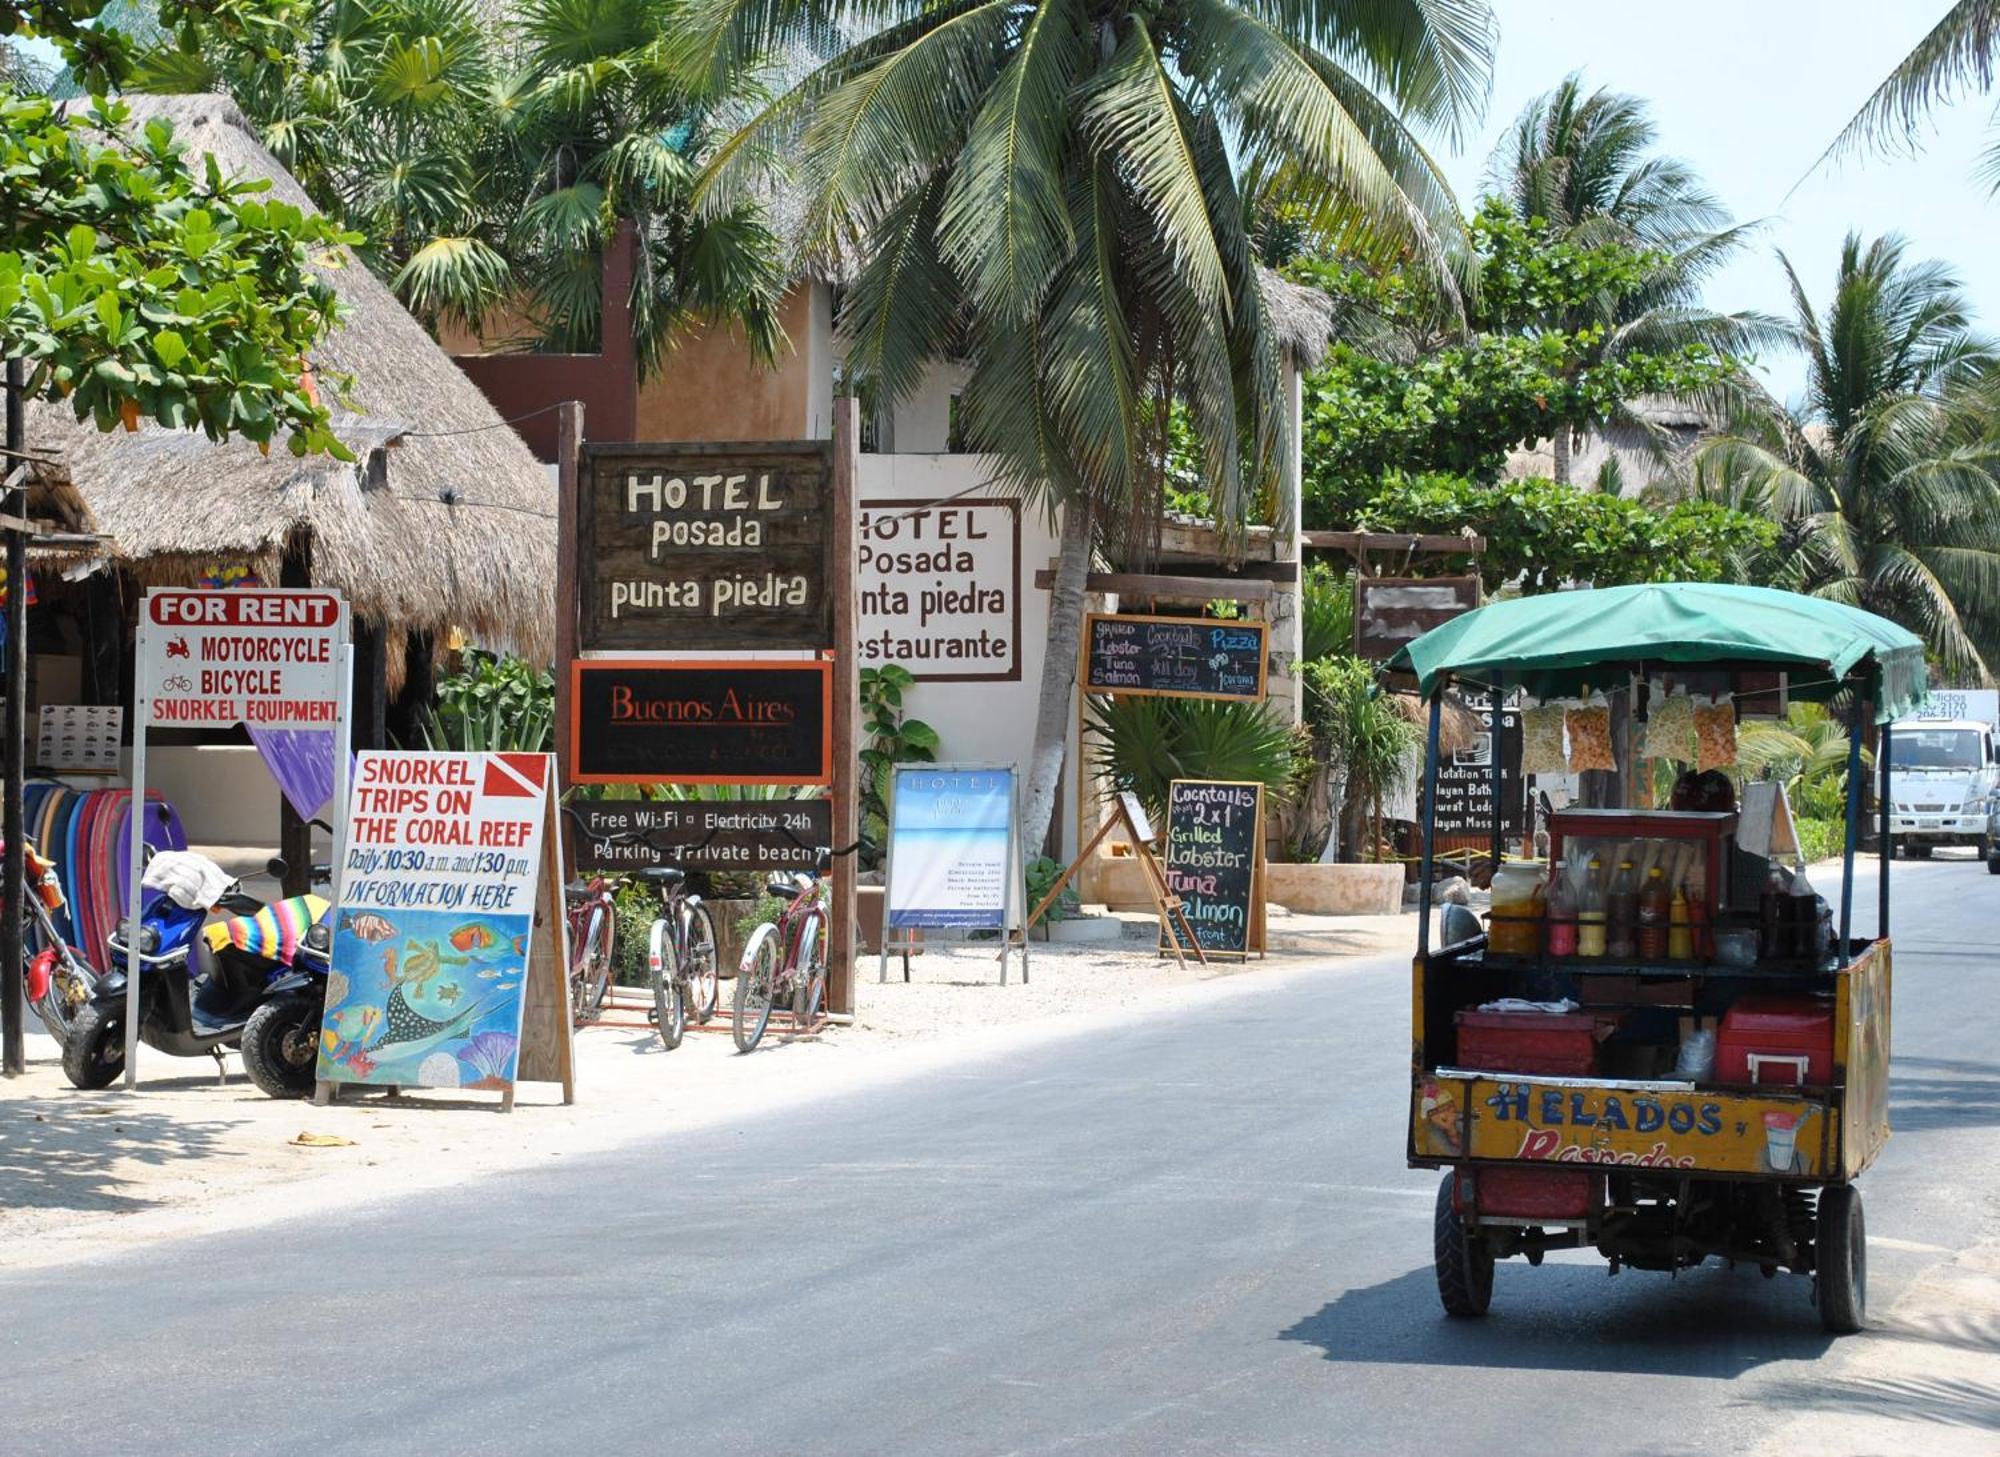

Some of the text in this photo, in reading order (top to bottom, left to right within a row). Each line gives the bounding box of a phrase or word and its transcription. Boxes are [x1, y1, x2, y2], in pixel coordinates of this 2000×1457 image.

[627, 474, 783, 512] HOTEL
[651, 515, 761, 558] posada
[611, 573, 807, 618] punta piedra
[861, 580, 1004, 627] nta piedra
[159, 598, 330, 624] FOR RENT
[201, 636, 330, 663] MOTORCYCLE
[858, 629, 1007, 658] staurante
[201, 670, 281, 695] BICYCLE
[153, 699, 338, 723] SNORKEL EQUIPMENT
[610, 684, 796, 721] Buenos Aires
[363, 758, 476, 786] SNORKEL
[357, 788, 473, 815] TRIPS ON
[353, 818, 534, 848] THE CORAL REEF
[591, 811, 812, 831] Free Wi-Fi Electricity 24h
[1170, 826, 1223, 844] Grilled
[452, 854, 475, 872] and
[594, 844, 811, 862] Parking Private beach
[1168, 843, 1246, 868] Lobster
[345, 879, 518, 910] INFORMATION HERE
[1167, 870, 1218, 897] Tuna
[1485, 1083, 1722, 1135] HELADOS
